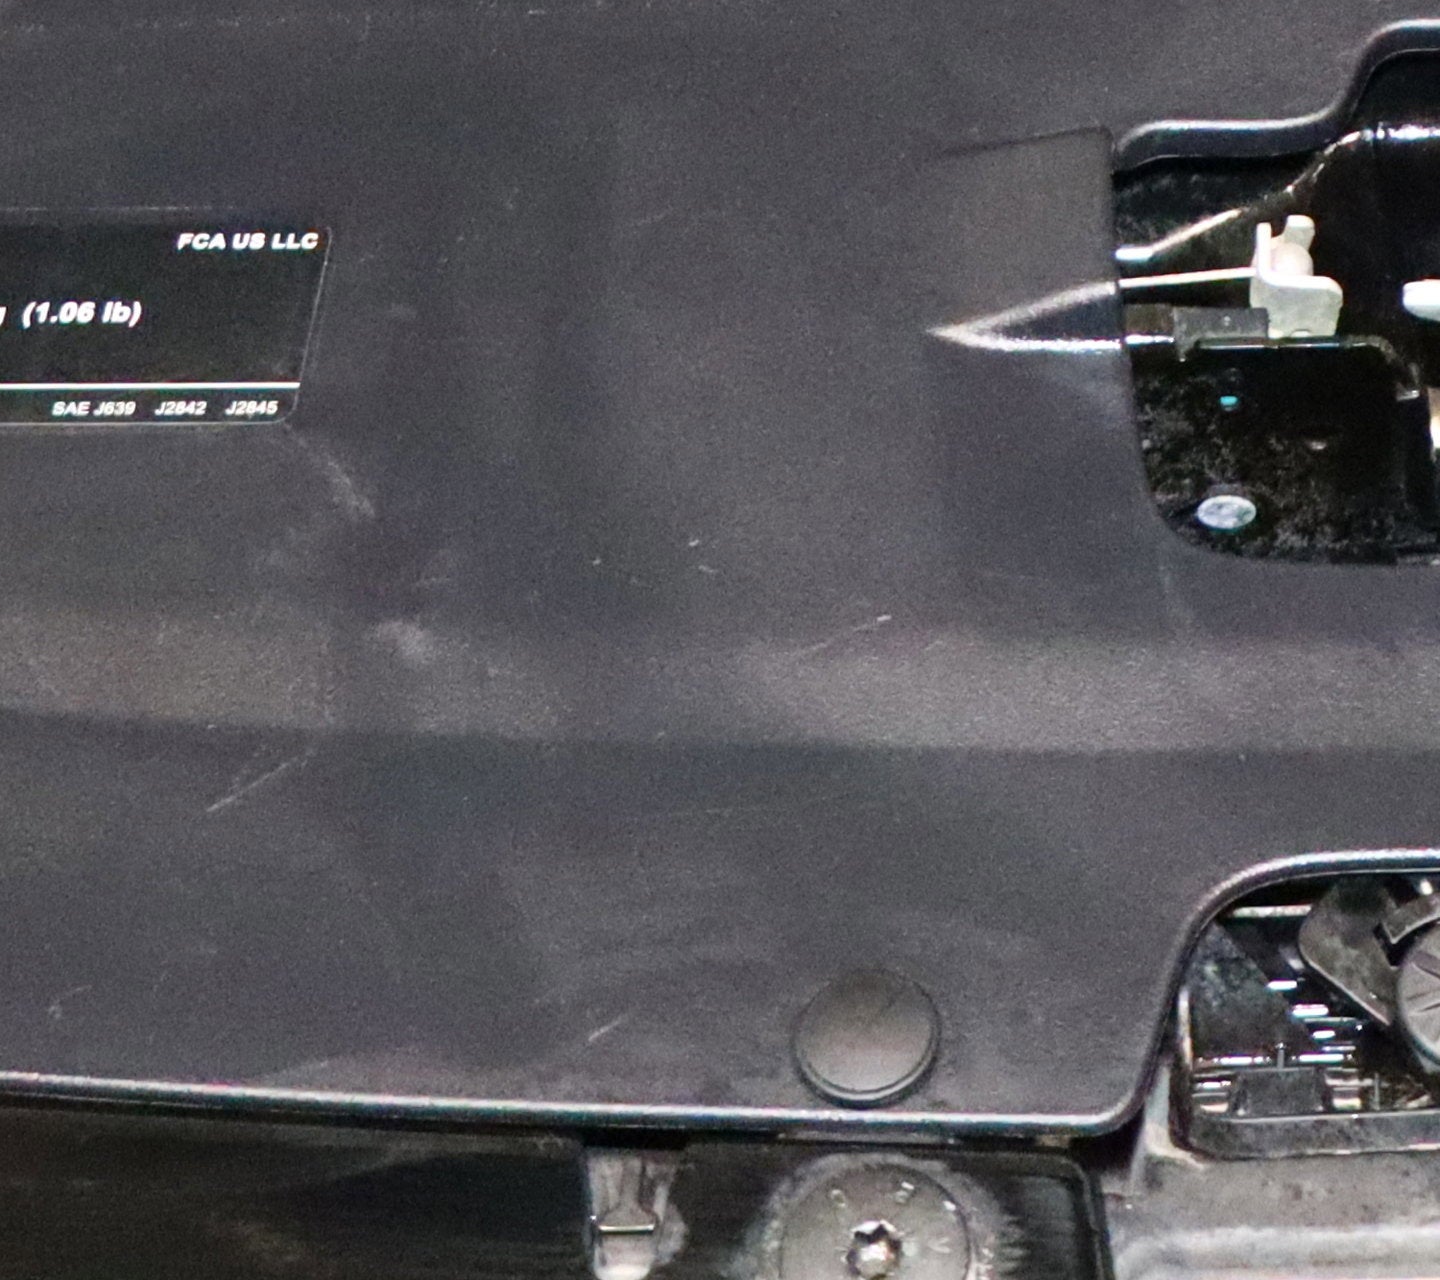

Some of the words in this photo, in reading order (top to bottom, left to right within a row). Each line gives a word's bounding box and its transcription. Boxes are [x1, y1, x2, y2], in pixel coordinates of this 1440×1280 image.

[177, 233, 226, 250] FCA
[232, 233, 265, 250] US
[271, 233, 319, 250] LLC
[22, 301, 95, 329] (1.06
[101, 301, 143, 328] lb)
[52, 401, 90, 417] SAE
[93, 401, 136, 417] J639
[154, 401, 207, 417] J2842
[225, 401, 279, 416] J2845
